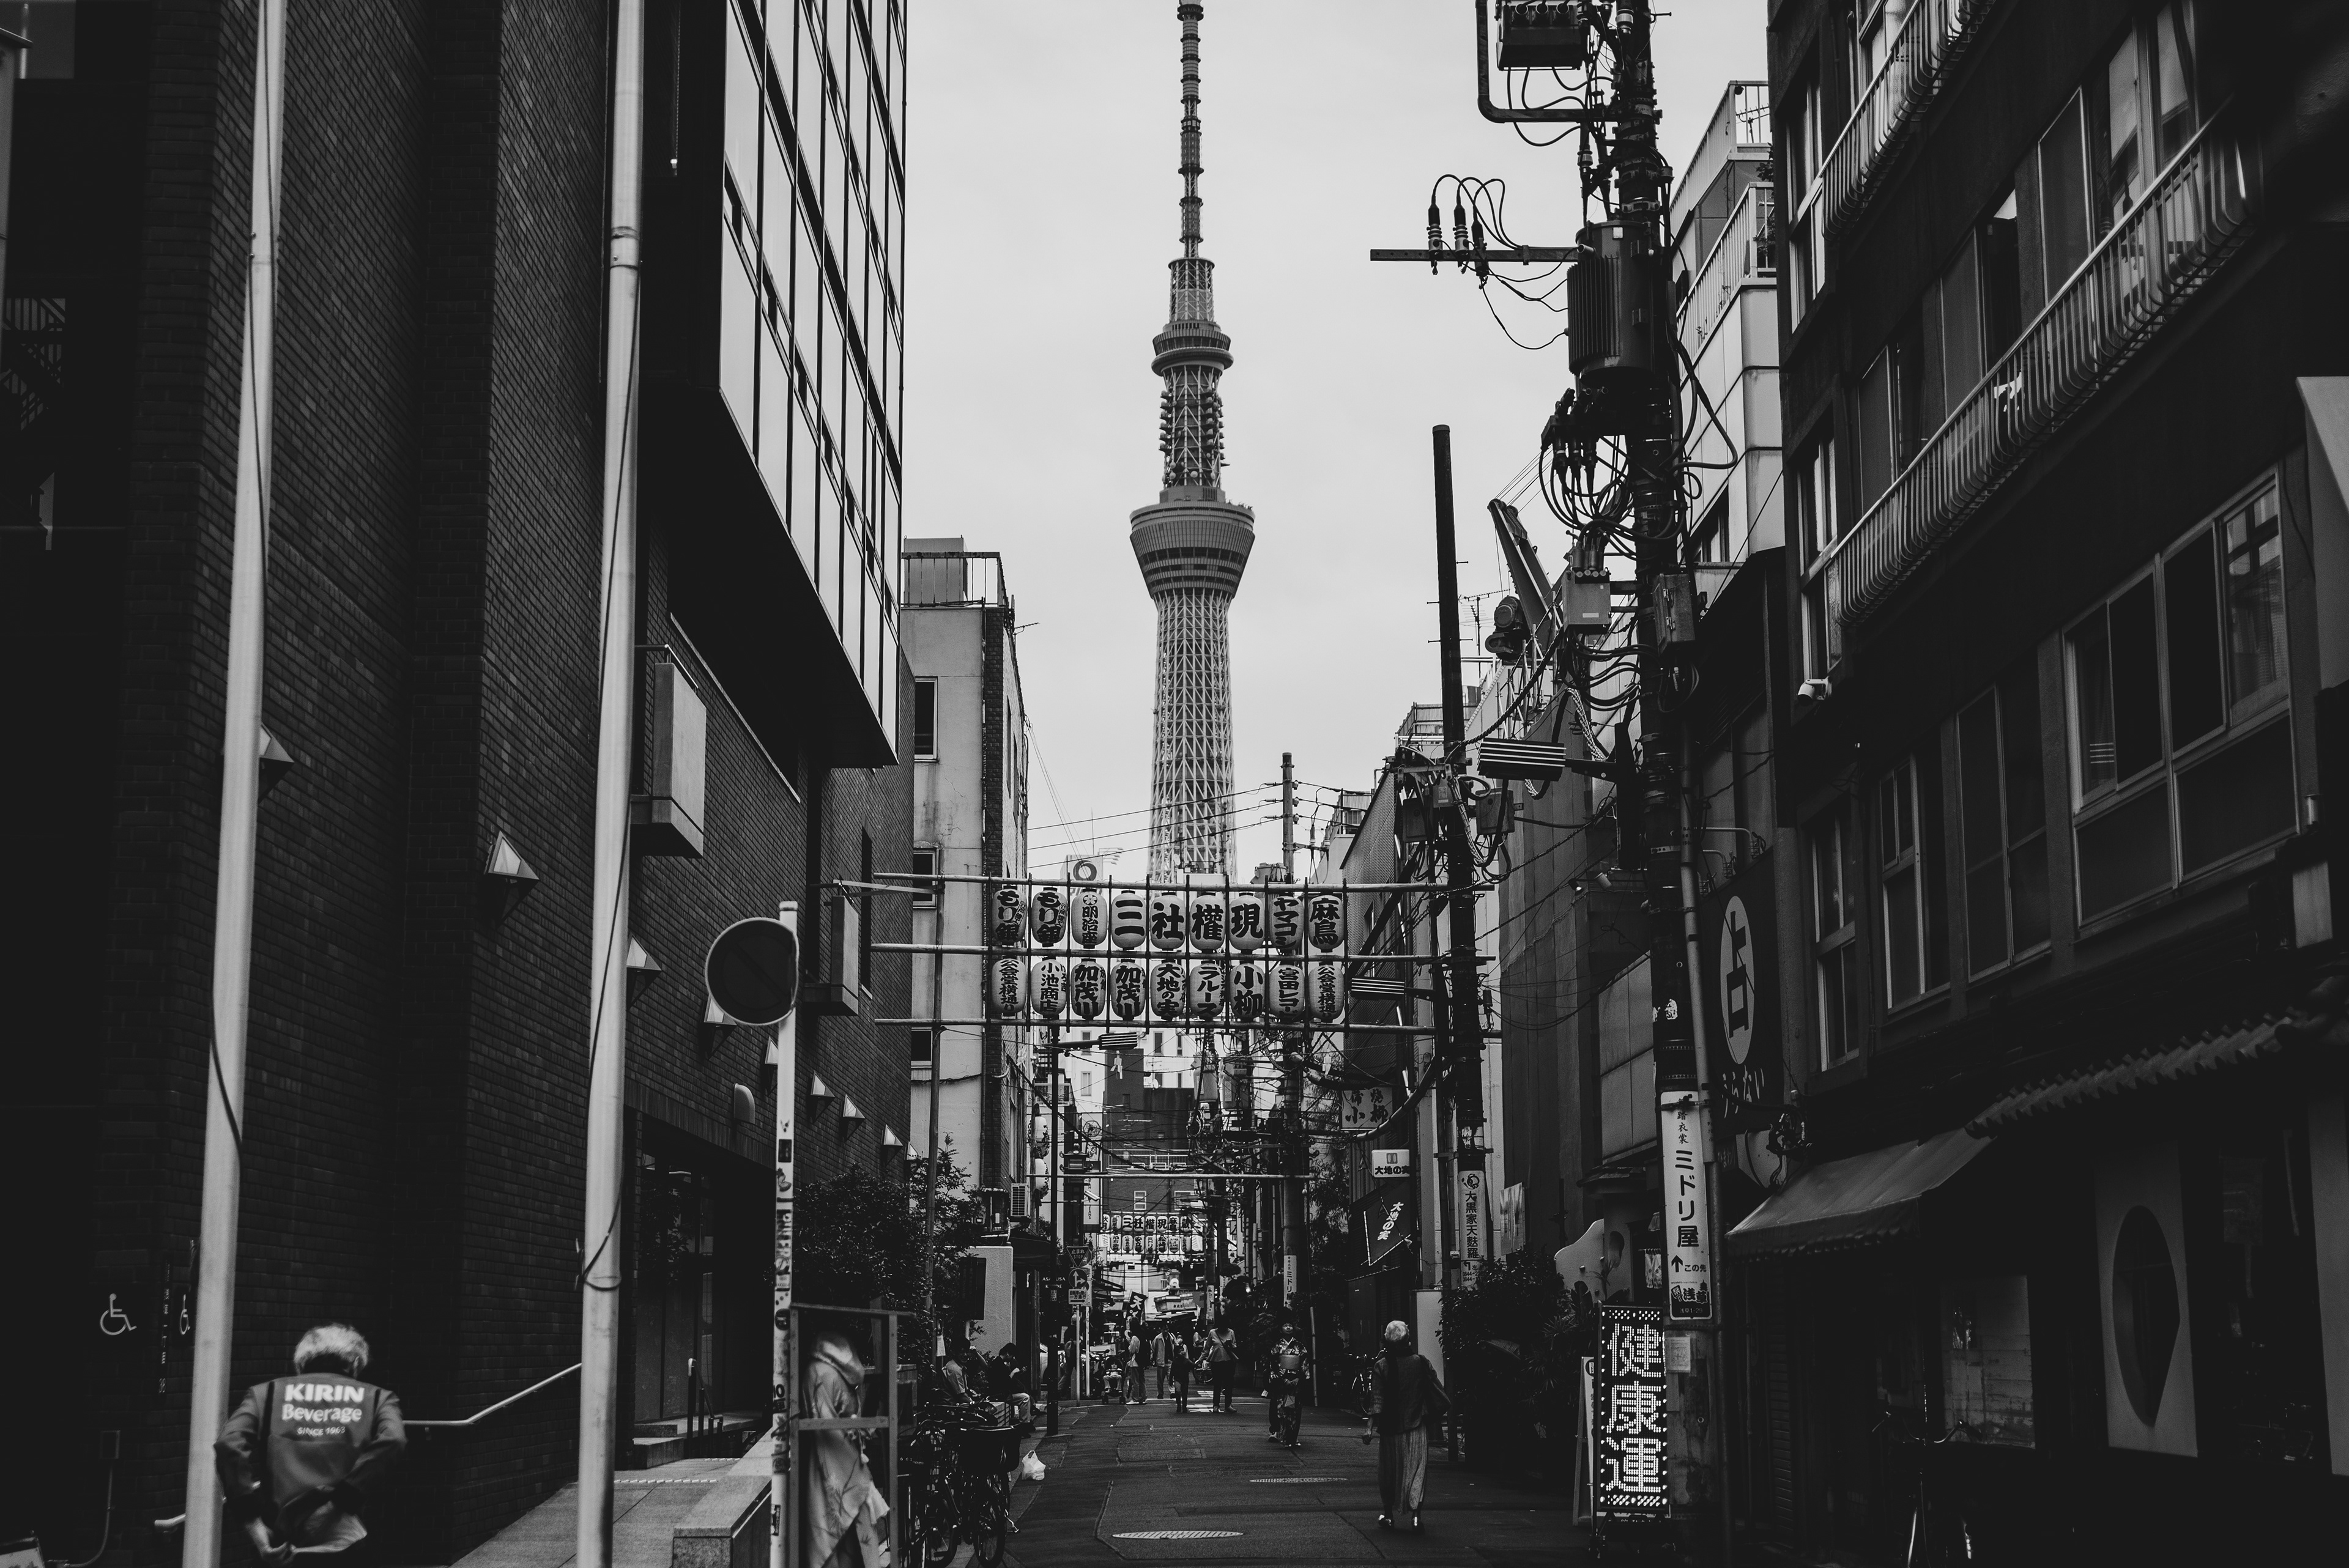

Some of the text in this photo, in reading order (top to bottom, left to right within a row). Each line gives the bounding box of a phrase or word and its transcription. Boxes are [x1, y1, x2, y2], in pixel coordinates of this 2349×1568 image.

[995, 890, 1020, 941] もり銀
[1036, 891, 1061, 942] もり銀
[1082, 906, 1099, 944] 明治座
[1274, 898, 1299, 949] ヤマコシ
[1310, 898, 1340, 945] 麻鳥
[998, 960, 1020, 1012] 公会堂横通り
[1040, 963, 1060, 1013] 小池商店
[1075, 964, 1099, 1017] 加茂川
[1116, 966, 1142, 1018] 加茂川
[1156, 964, 1181, 1016] 大地の実
[1197, 966, 1220, 1015] ラルース
[1233, 966, 1264, 1016] 小柳
[1317, 966, 1336, 1018] 公会堂横通り
[1676, 1098, 1689, 1145] 踏衣裳
[1377, 1202, 1405, 1241] 大地の実
[1675, 1150, 1699, 1248] ミドリ屋
[1684, 1264, 1707, 1273] この先
[1683, 1288, 1707, 1303] 浅草
[281, 1403, 363, 1425] Beverage
[284, 1383, 365, 1403] KIRIN
[1607, 1323, 1663, 1494] 健康運
[297, 1426, 346, 1437] SINCE 1963
